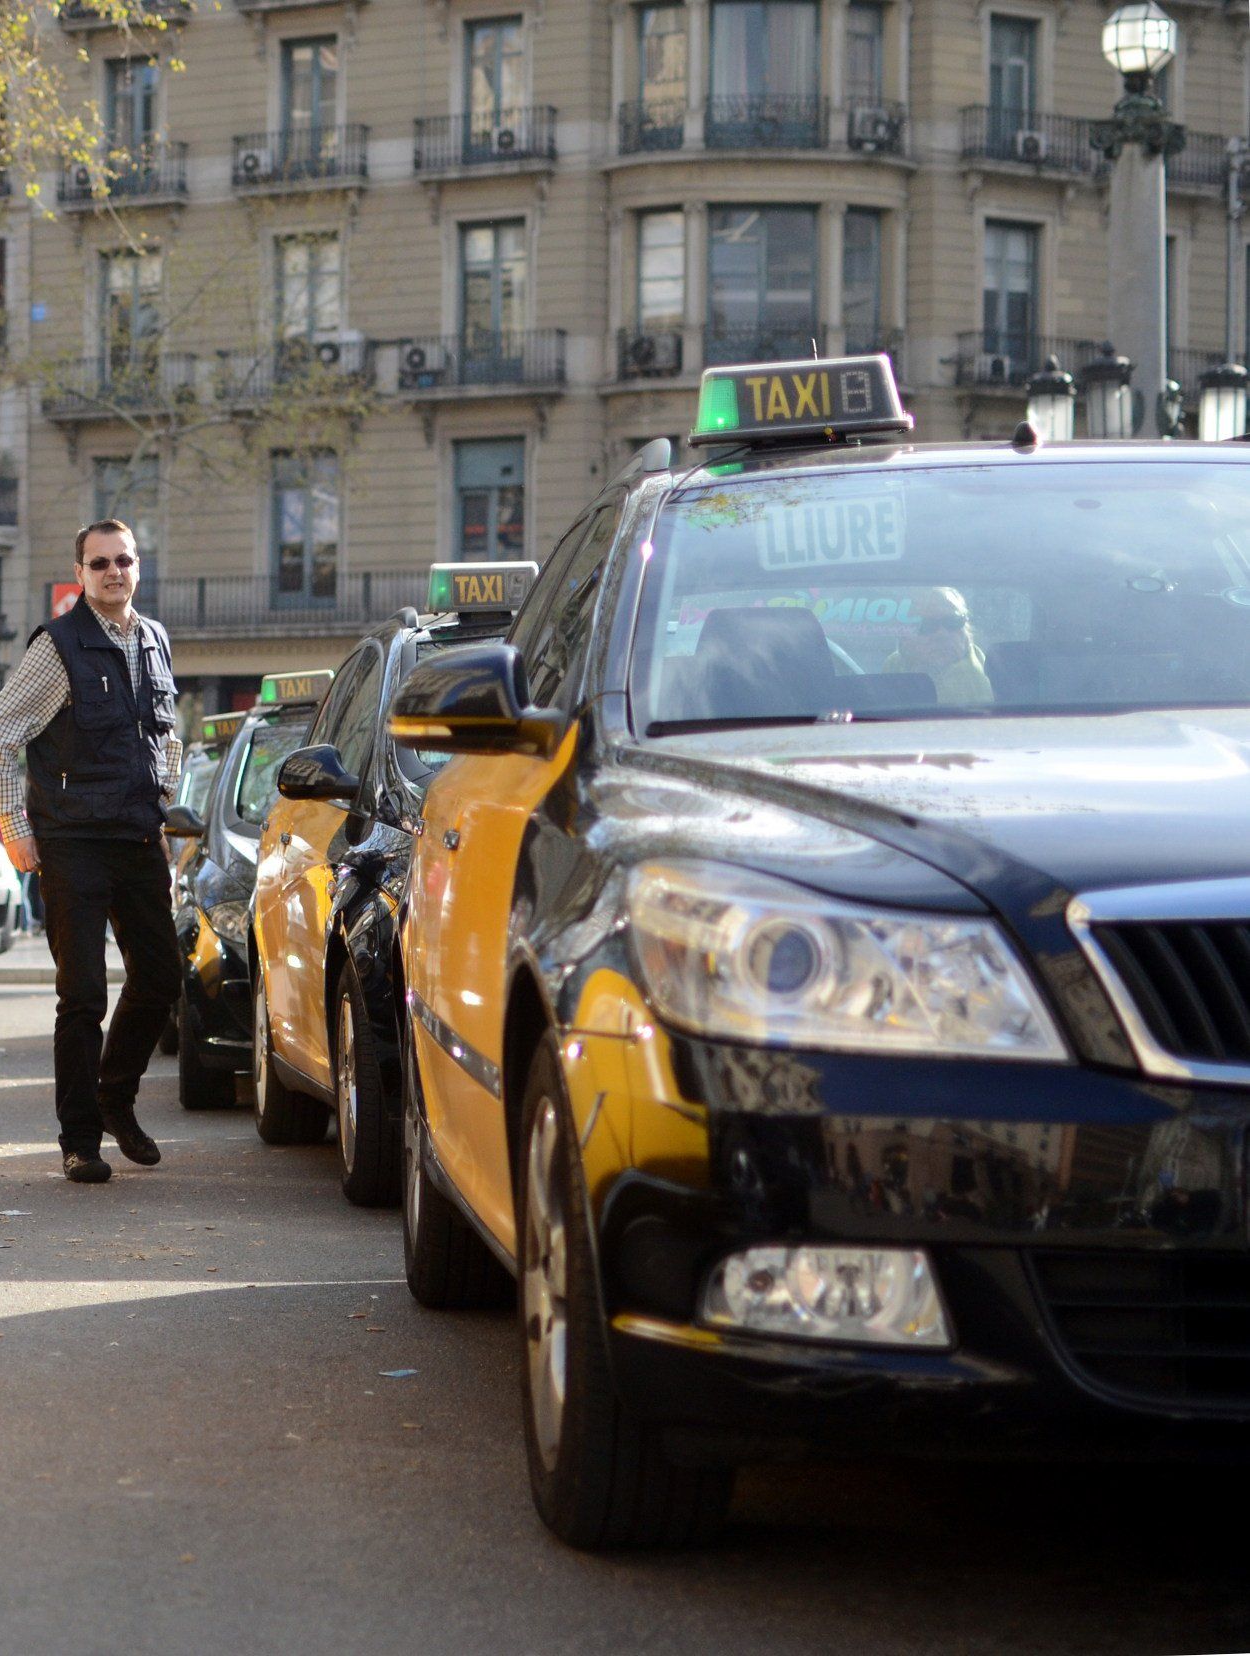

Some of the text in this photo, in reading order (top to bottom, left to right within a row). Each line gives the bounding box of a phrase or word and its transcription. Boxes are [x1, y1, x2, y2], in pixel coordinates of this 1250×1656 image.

[745, 371, 831, 421] TAXI
[766, 501, 897, 566] LLIURE
[454, 574, 503, 603] TAXI
[278, 679, 312, 699] TAXI
[216, 720, 238, 737] TAX
